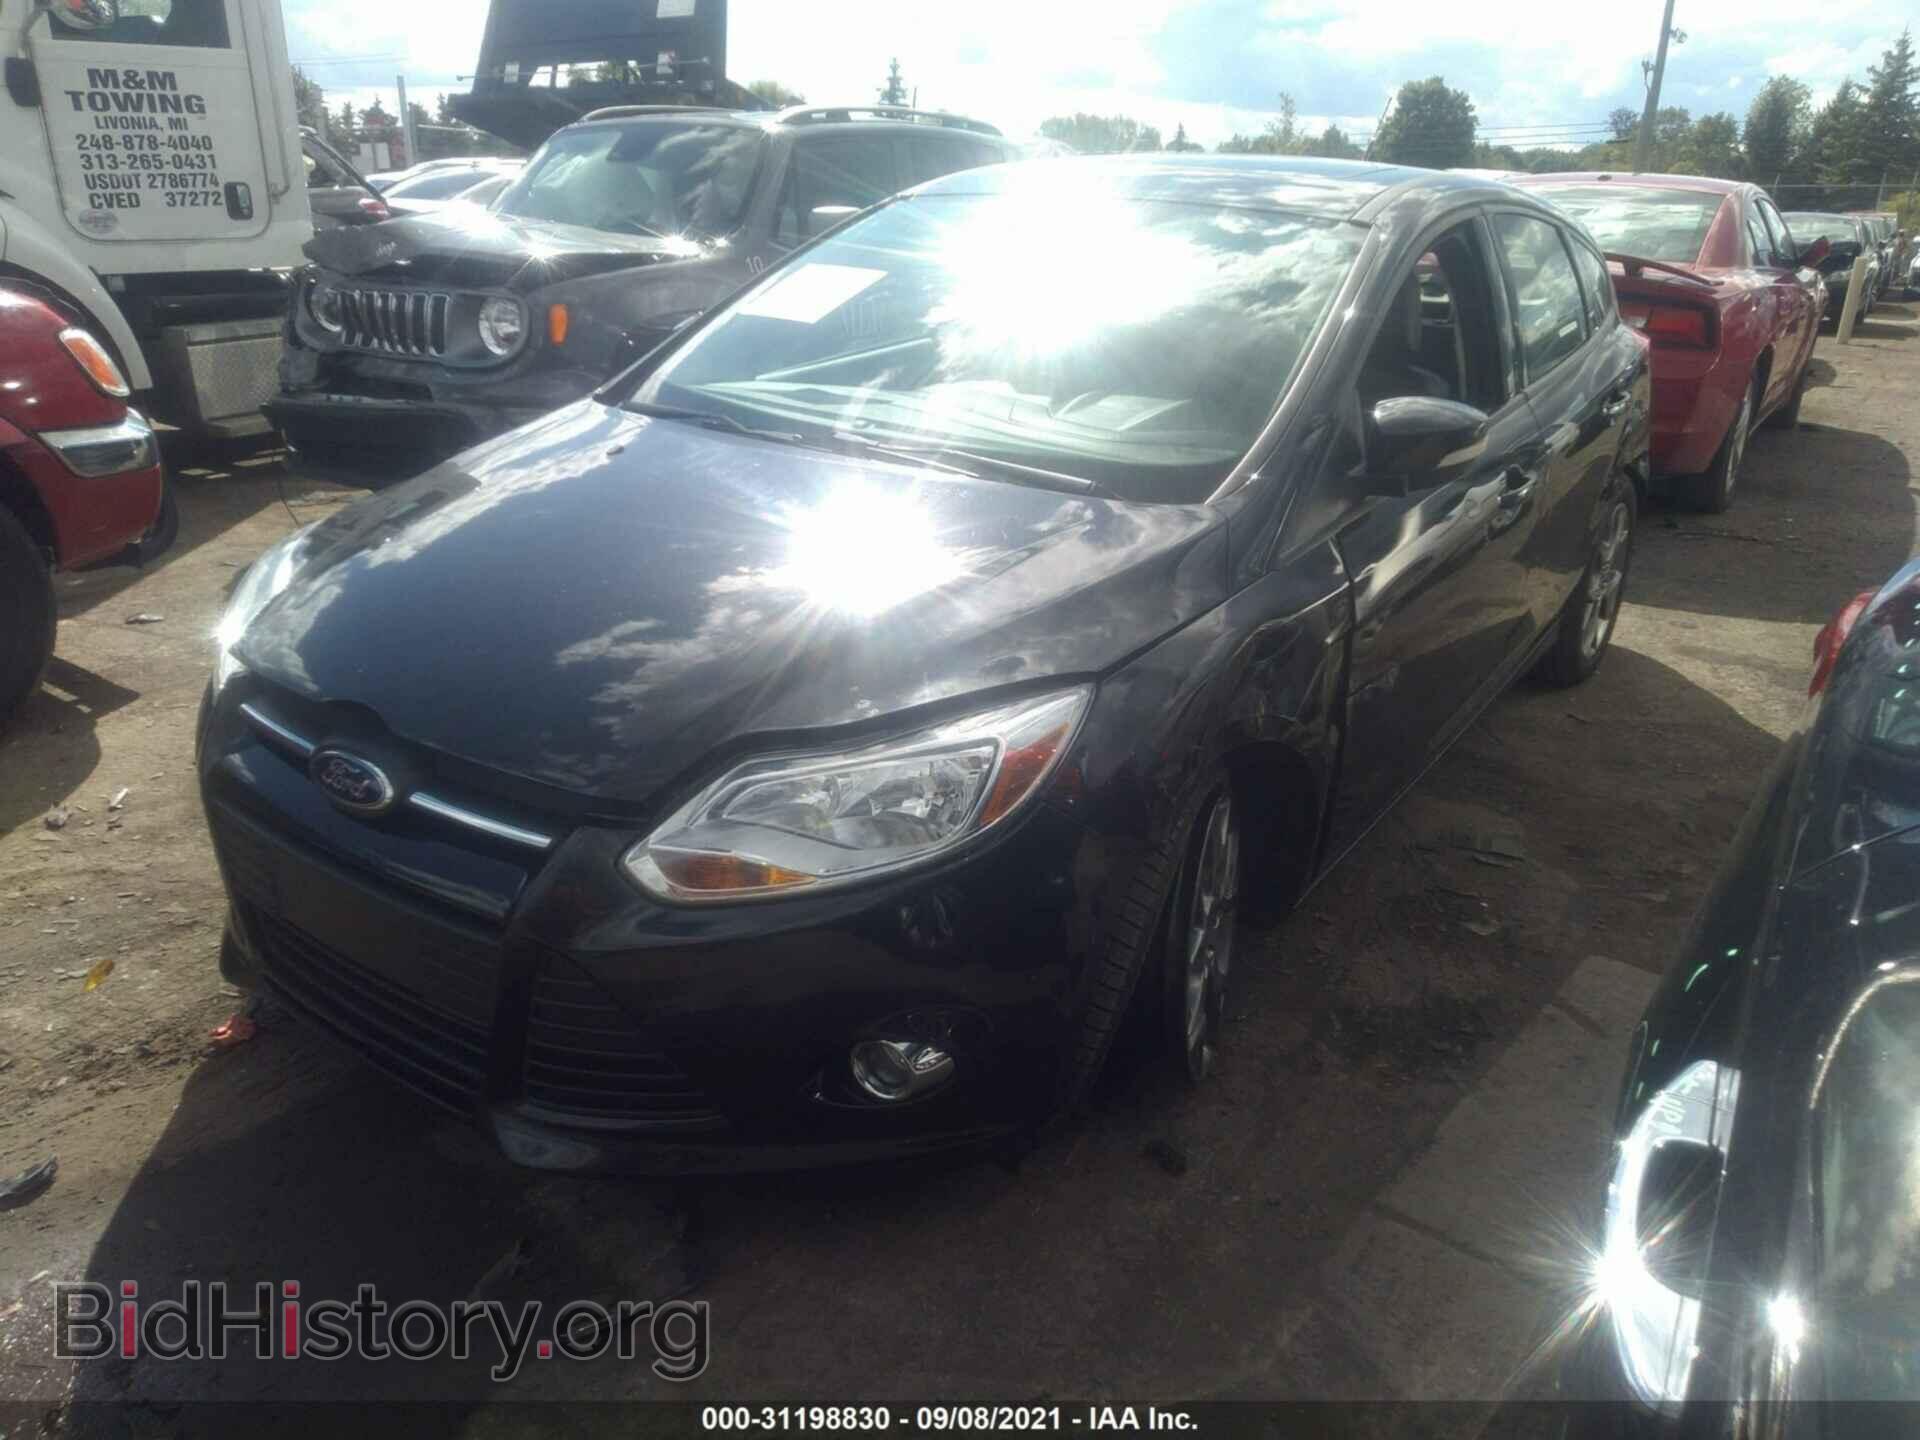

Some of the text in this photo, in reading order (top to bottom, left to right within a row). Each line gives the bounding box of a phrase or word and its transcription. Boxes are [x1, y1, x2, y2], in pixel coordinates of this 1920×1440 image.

[87, 68, 178, 91] M&M
[64, 90, 207, 115] TOWING
[94, 115, 189, 132] LIVONIA, MI
[75, 133, 213, 151] 248-878-4040
[80, 153, 217, 170] 313-265-0431
[84, 173, 220, 190] USDOT 2786774
[89, 191, 223, 209] CVED 37272
